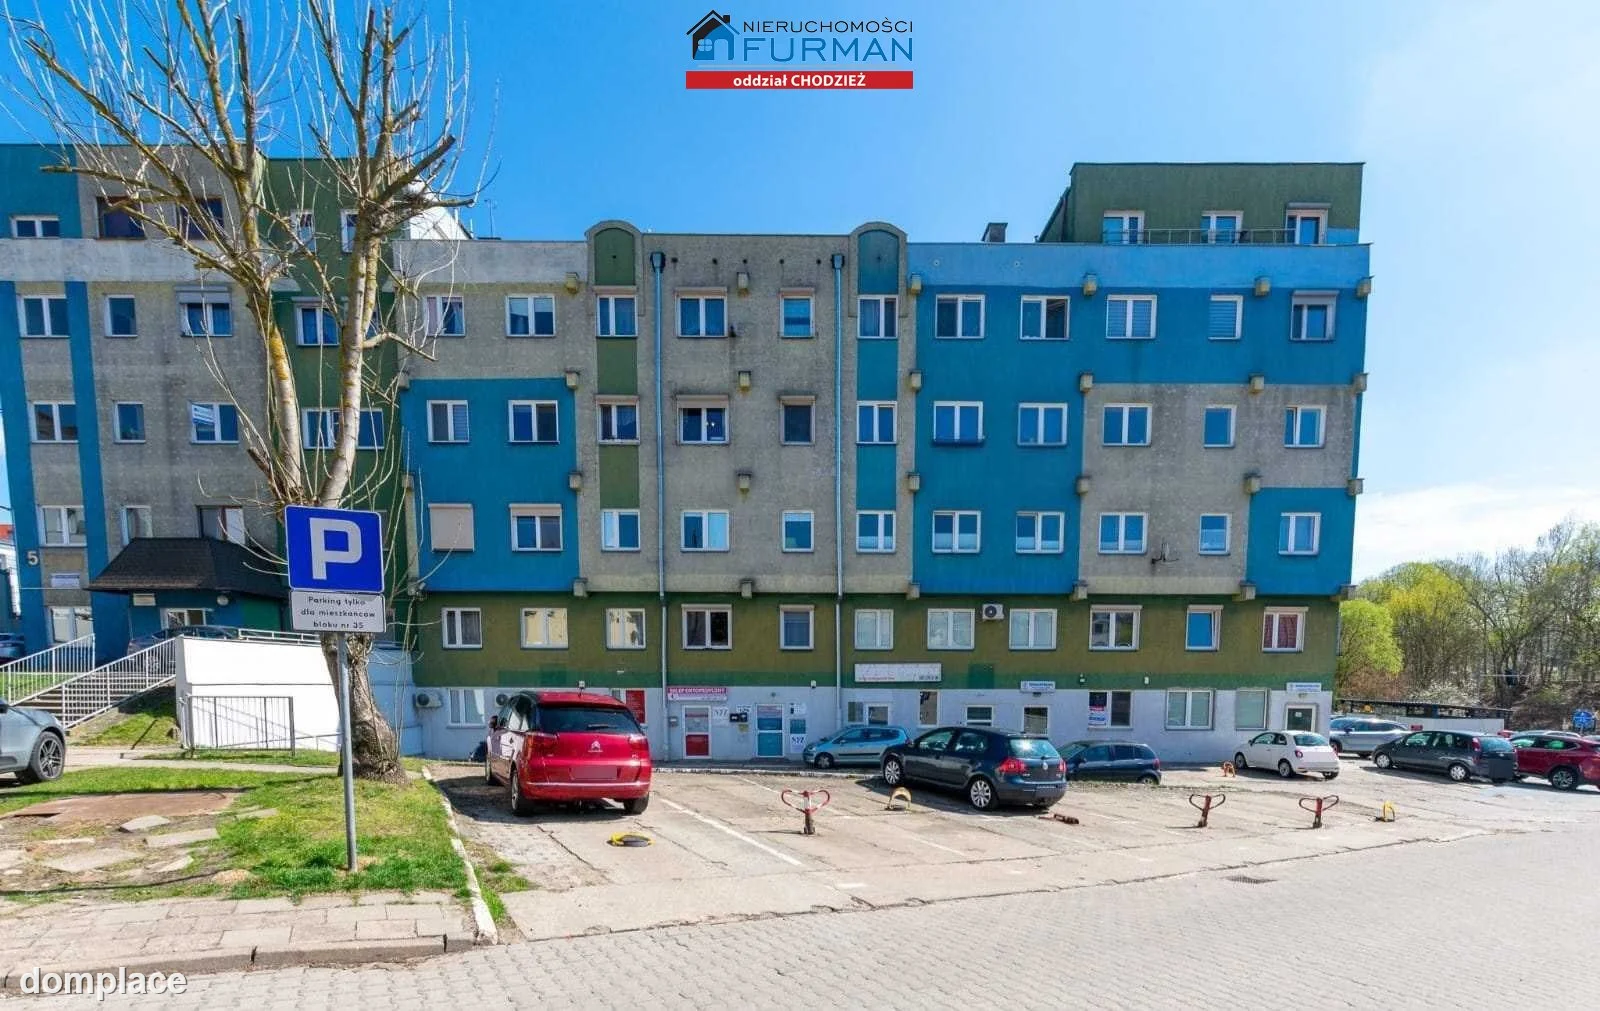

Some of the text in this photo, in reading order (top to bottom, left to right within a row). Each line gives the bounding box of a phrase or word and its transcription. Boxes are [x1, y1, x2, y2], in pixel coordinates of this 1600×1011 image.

[309, 517, 363, 580] P
[27, 551, 39, 566] 5
[308, 596, 366, 606] Parking tylko
[301, 608, 315, 616] dla
[313, 620, 338, 628] bloku
